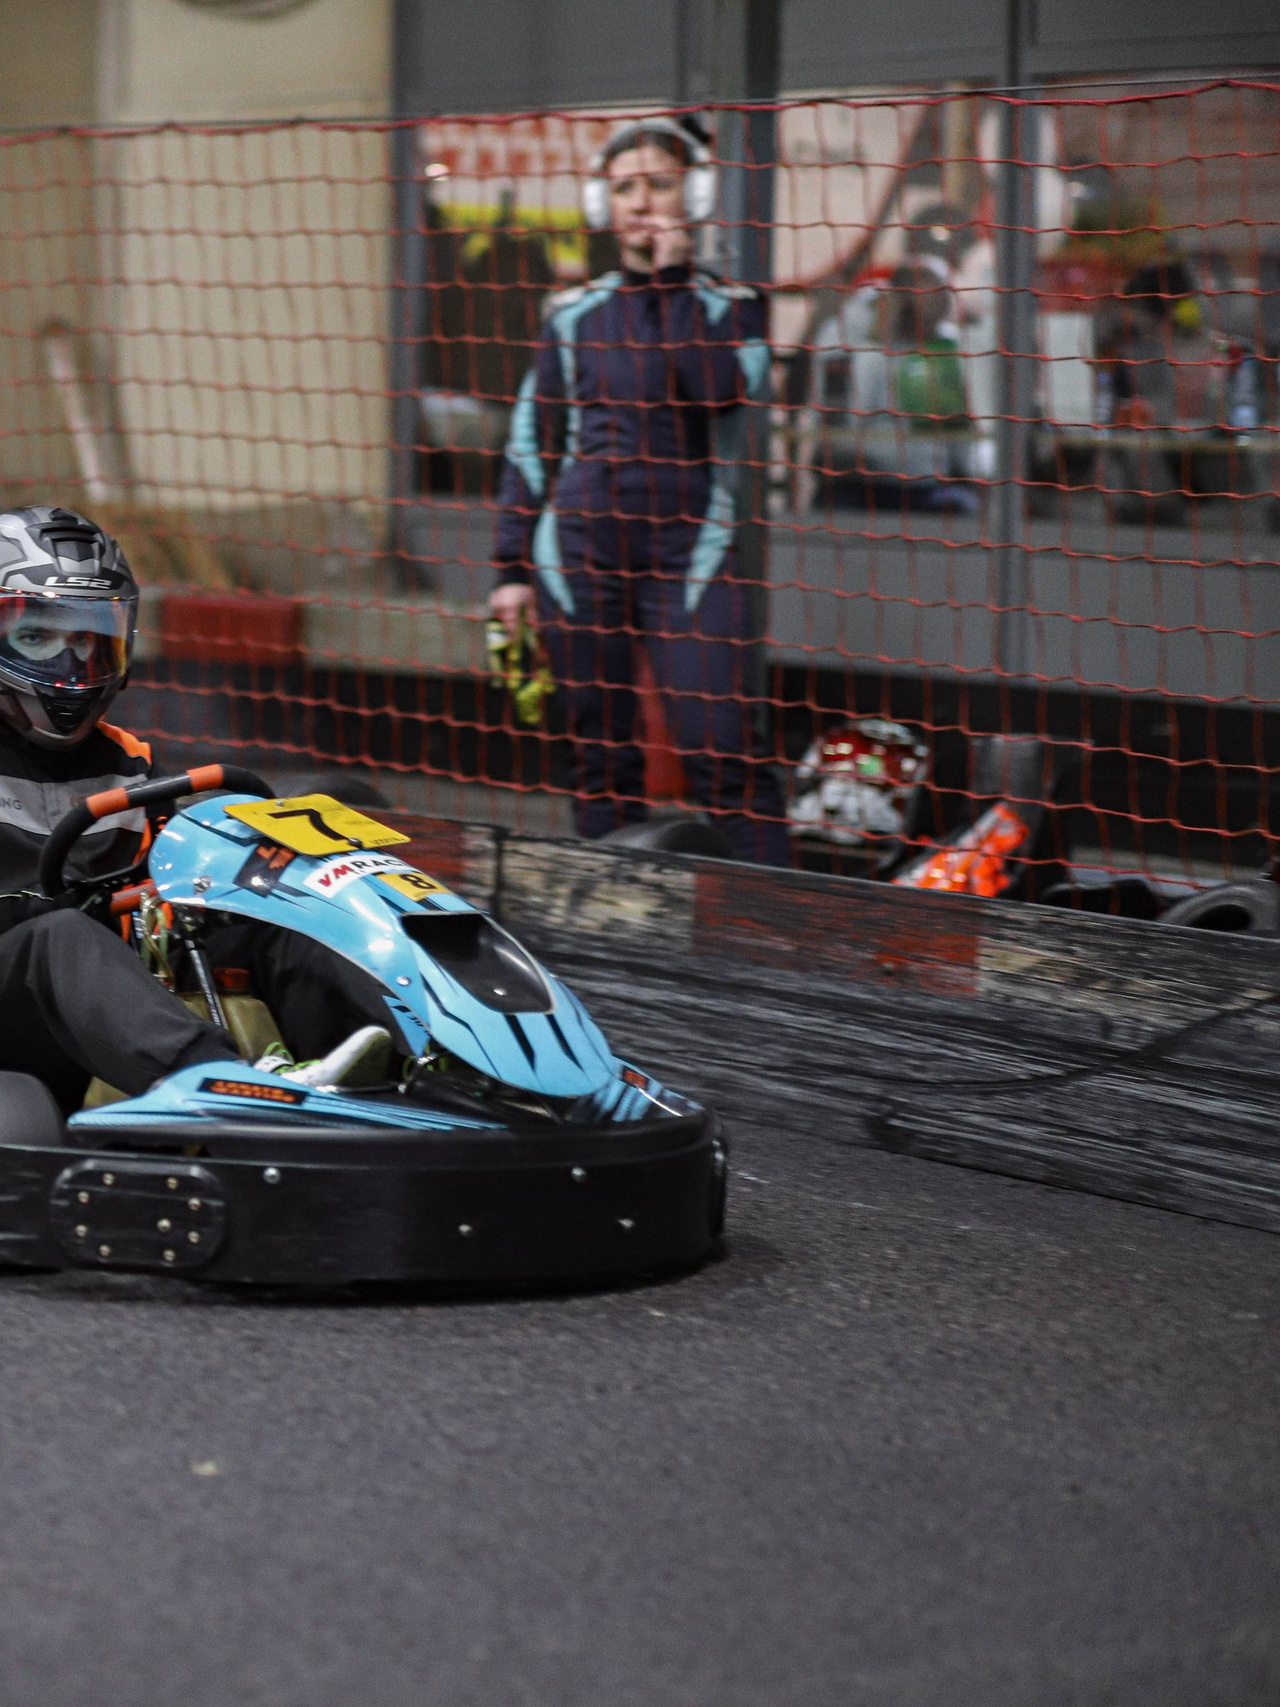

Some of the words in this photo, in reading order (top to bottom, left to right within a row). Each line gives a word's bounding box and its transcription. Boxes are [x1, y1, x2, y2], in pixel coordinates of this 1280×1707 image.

[44, 576, 112, 590] LS2
[266, 809, 354, 841] 7
[398, 873, 437, 889] 8
